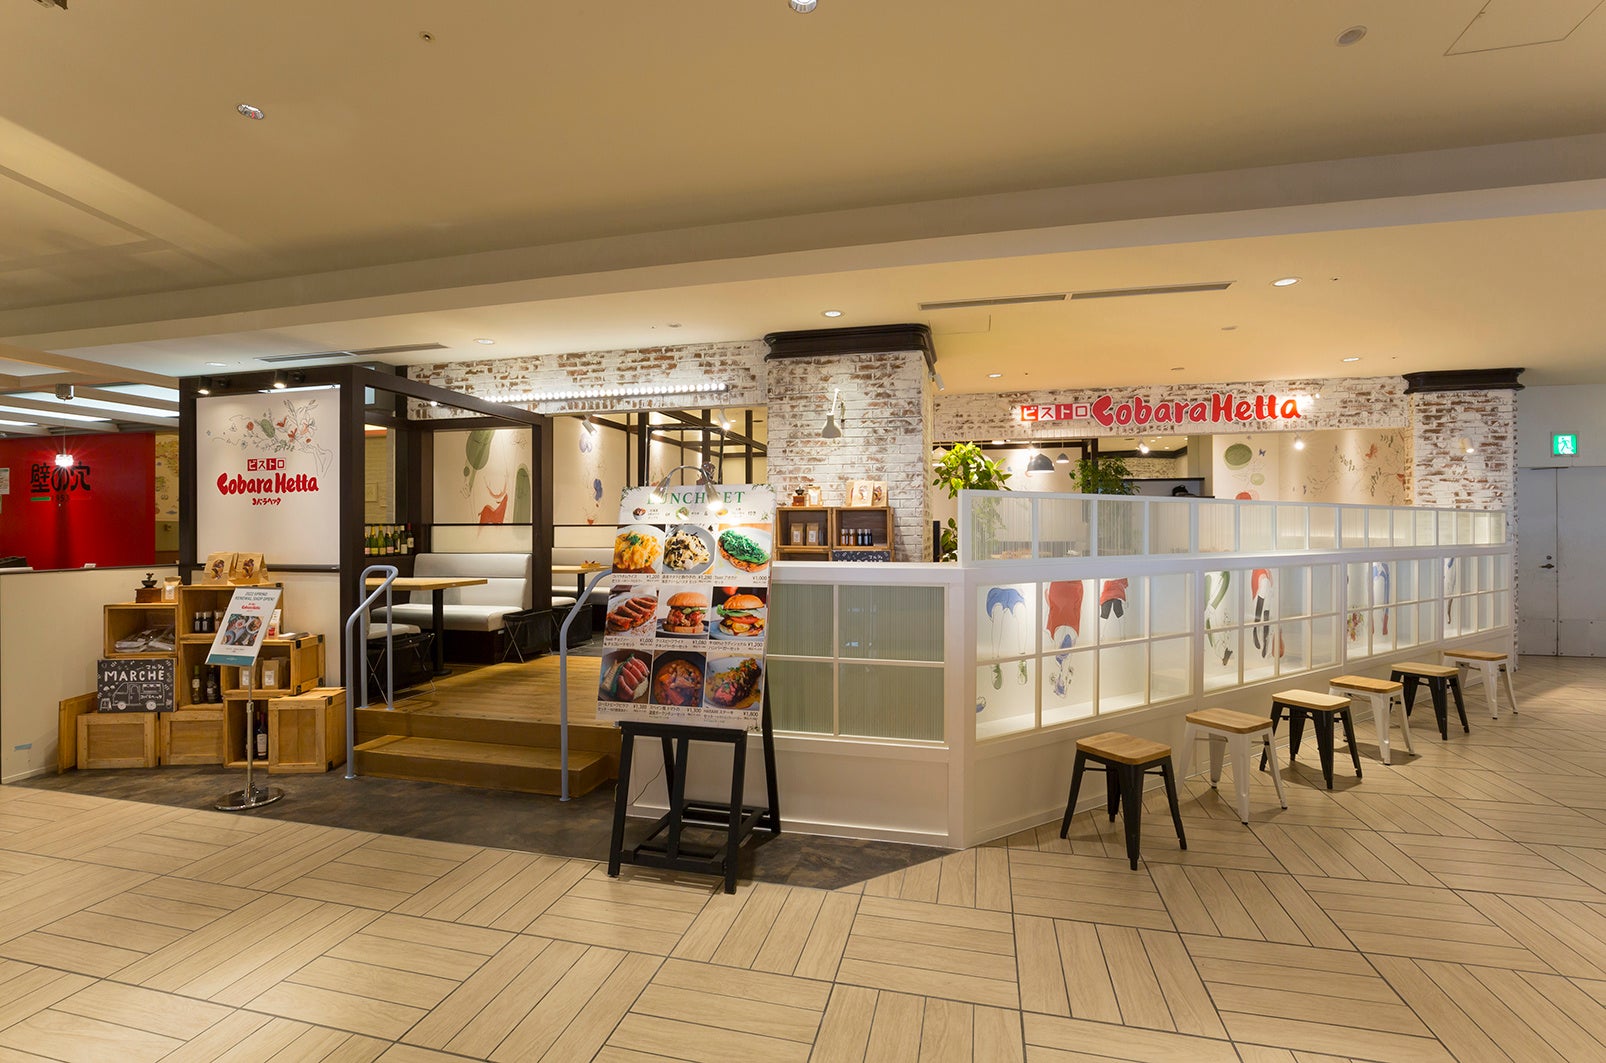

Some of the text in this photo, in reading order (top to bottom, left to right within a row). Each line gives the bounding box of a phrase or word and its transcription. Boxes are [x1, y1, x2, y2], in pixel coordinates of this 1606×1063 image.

[1021, 404, 1090, 421] ビストロ
[247, 458, 286, 471] ビストロ
[30, 461, 92, 493] 壁の穴
[252, 498, 282, 506] コバラヘッタ
[104, 670, 165, 682] MARCHE
